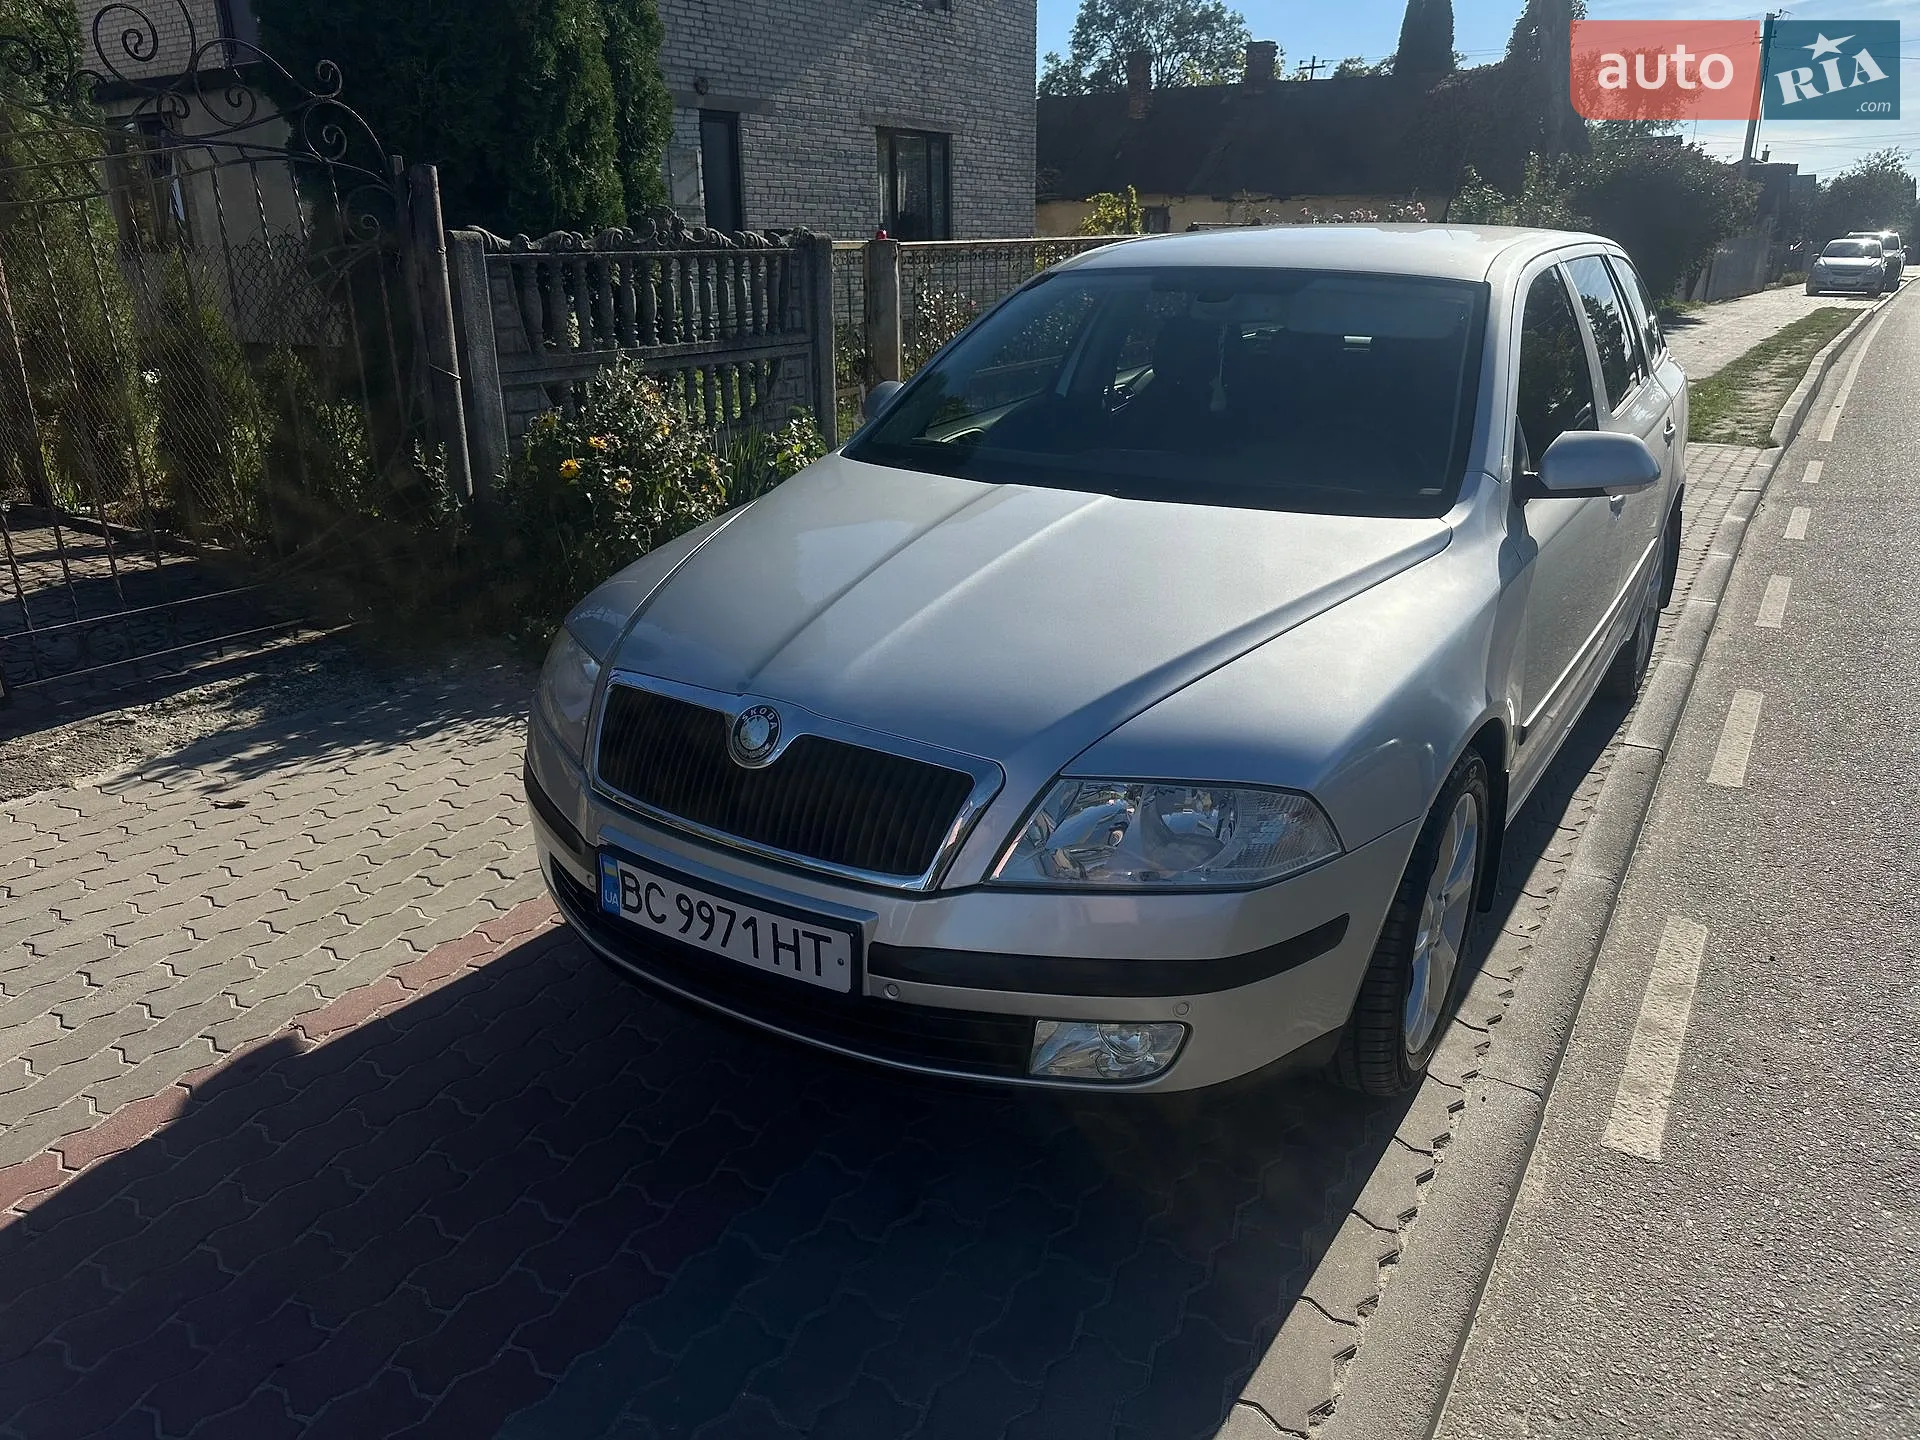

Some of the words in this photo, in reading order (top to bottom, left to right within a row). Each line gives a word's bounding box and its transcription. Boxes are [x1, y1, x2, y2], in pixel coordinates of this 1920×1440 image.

[604, 891, 618, 906] UA
[620, 868, 667, 924] BC
[675, 893, 759, 959] 9971
[771, 922, 832, 976] HT
